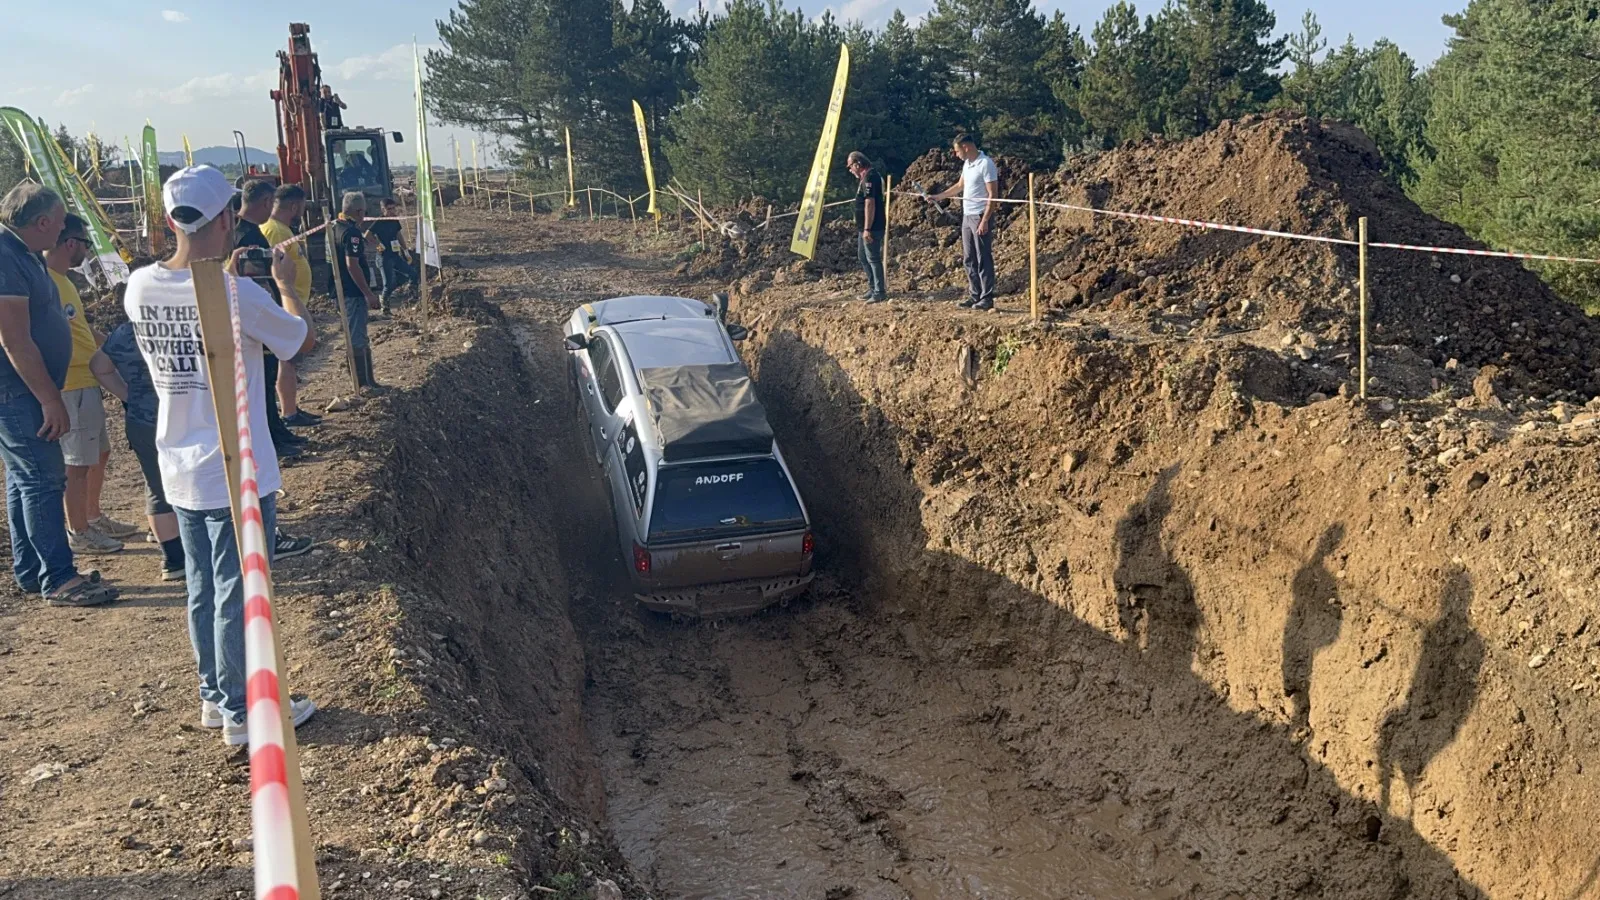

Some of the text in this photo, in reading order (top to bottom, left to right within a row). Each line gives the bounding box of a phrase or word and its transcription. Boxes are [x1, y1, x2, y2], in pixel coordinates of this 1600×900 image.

[139, 305, 199, 322] IN THE
[695, 472, 744, 486] ANDOFF
